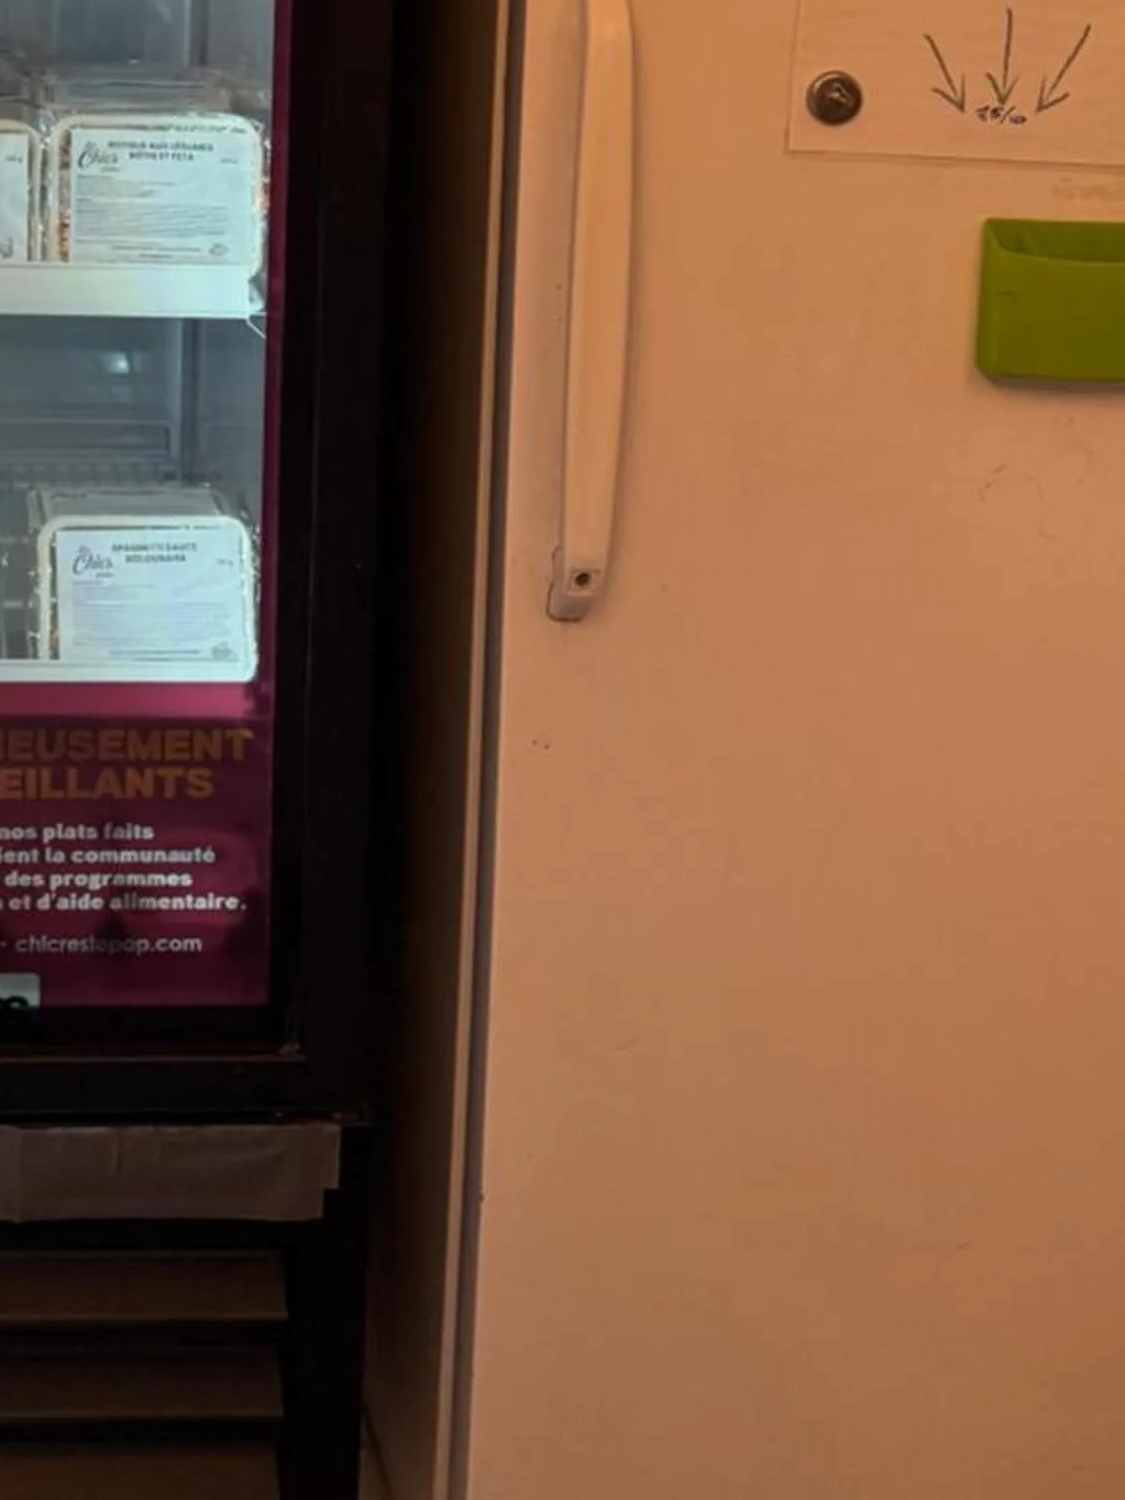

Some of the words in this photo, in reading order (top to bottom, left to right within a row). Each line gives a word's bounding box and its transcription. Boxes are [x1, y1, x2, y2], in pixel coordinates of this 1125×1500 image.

[42, 823, 98, 844] plats
[104, 823, 154, 841] faits
[45, 847, 65, 864] la
[70, 846, 216, 864] communauté
[4, 871, 44, 888] des
[49, 871, 193, 892] programmes
[8, 895, 31, 911] et
[36, 893, 104, 911] d'aide
[108, 893, 247, 911] alimentaire.
[15, 935, 203, 956] chicrestopop.com
